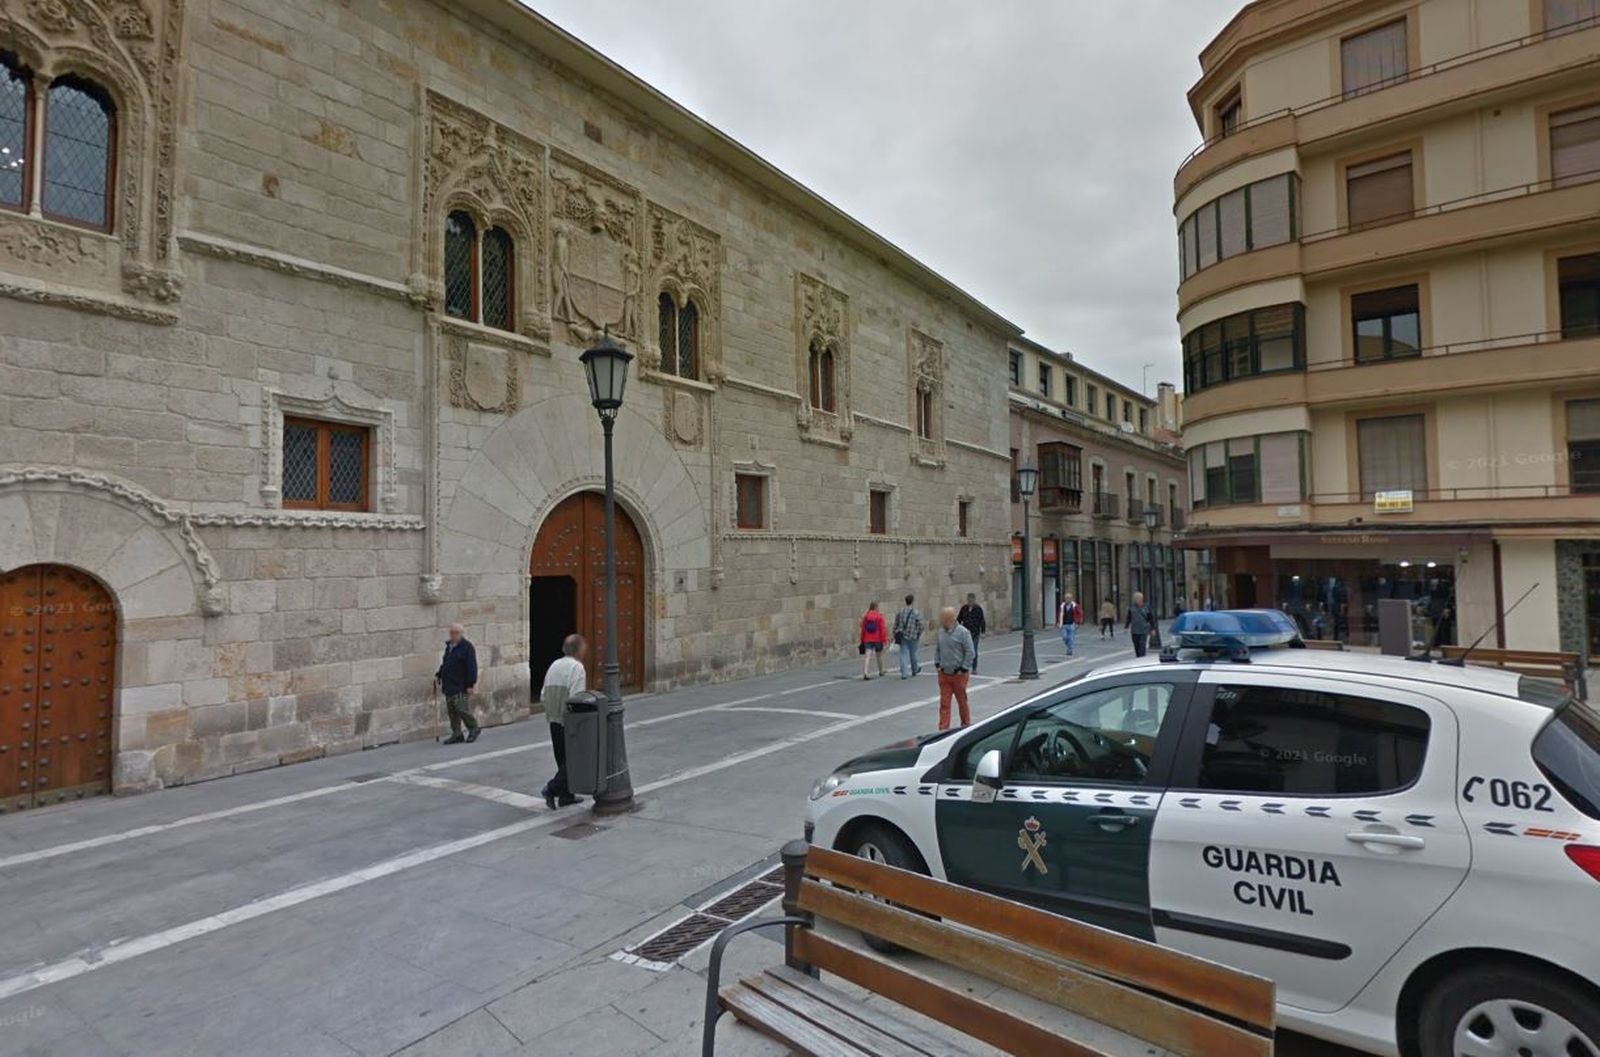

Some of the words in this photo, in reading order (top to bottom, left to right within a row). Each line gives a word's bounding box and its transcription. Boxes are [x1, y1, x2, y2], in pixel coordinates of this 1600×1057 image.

[1490, 778, 1554, 812] 062
[1202, 845, 1342, 887] GUARDIA
[1233, 880, 1314, 916] CIVIL
